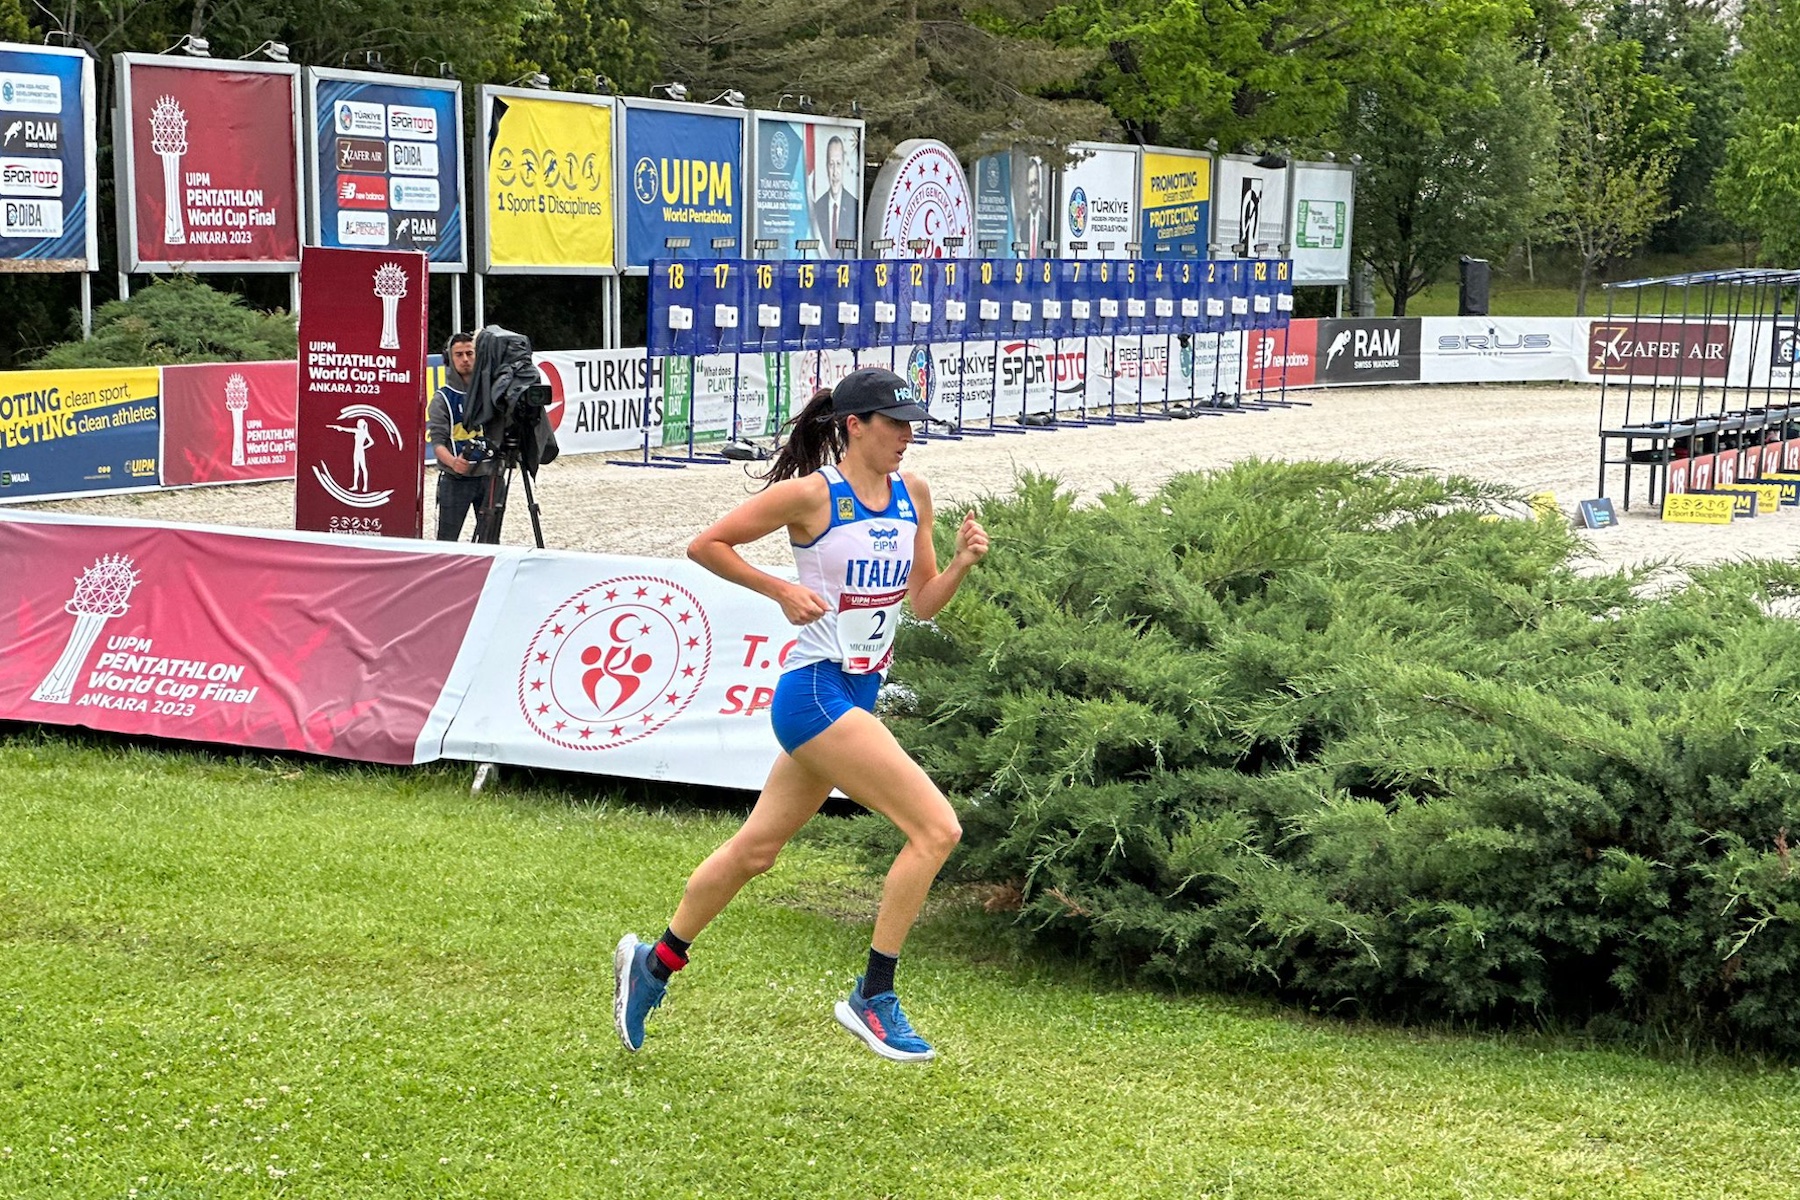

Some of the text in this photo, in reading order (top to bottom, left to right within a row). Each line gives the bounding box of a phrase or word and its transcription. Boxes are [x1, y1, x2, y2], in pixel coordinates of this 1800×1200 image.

[25, 120, 58, 142] RAM
[185, 171, 211, 187] UIPM
[661, 157, 732, 206] UIPM
[1151, 172, 1198, 192] PROMOTING
[186, 188, 264, 206] PENTATHLON
[497, 192, 602, 219] 1 Sport 5 Disciplines
[1090, 197, 1128, 213] TÜRKİYE
[186, 207, 276, 230] World Cup Final
[663, 206, 732, 224] World Pentathlon
[1149, 205, 1200, 229] PROTECTING
[411, 218, 437, 235] RAM
[189, 230, 253, 244] ANKARA 2023
[668, 261, 1288, 289] 18 17 16 15 14 13 12 11 10 9 8 7 6 5 4 3 2 1 R2 R1
[309, 341, 336, 352] UIPM
[1354, 328, 1400, 357] RAM
[308, 353, 397, 369] PENTATHLON
[1354, 359, 1399, 369] SWISS WATCHES
[308, 366, 411, 384] World Cup Final
[574, 357, 664, 393] TURKISH
[64, 390, 97, 408] clean
[99, 382, 132, 405] sport,
[308, 382, 380, 394] ANKARA 2023
[78, 412, 110, 434] clean
[112, 405, 157, 426] athletes
[246, 428, 295, 441] PENTATHLON
[246, 440, 269, 454] World
[269, 440, 284, 454] Cup
[132, 459, 155, 473] UIPM
[246, 454, 286, 466] ANKARA 2023
[11, 472, 30, 483] WADA
[1672, 467, 1686, 494] 18
[1695, 464, 1710, 490] 17
[1721, 458, 1734, 484] 16
[1745, 454, 1758, 479] 15
[1766, 450, 1779, 474] 14
[873, 540, 898, 552] FIPM
[845, 559, 911, 588] ITALIA
[851, 595, 871, 604] UIPM
[867, 610, 887, 641] 2
[106, 635, 153, 653] UIPM
[96, 652, 245, 683] PENTATHLON
[87, 671, 259, 704] World Cup Final
[76, 692, 197, 717] ANKARA 2023
